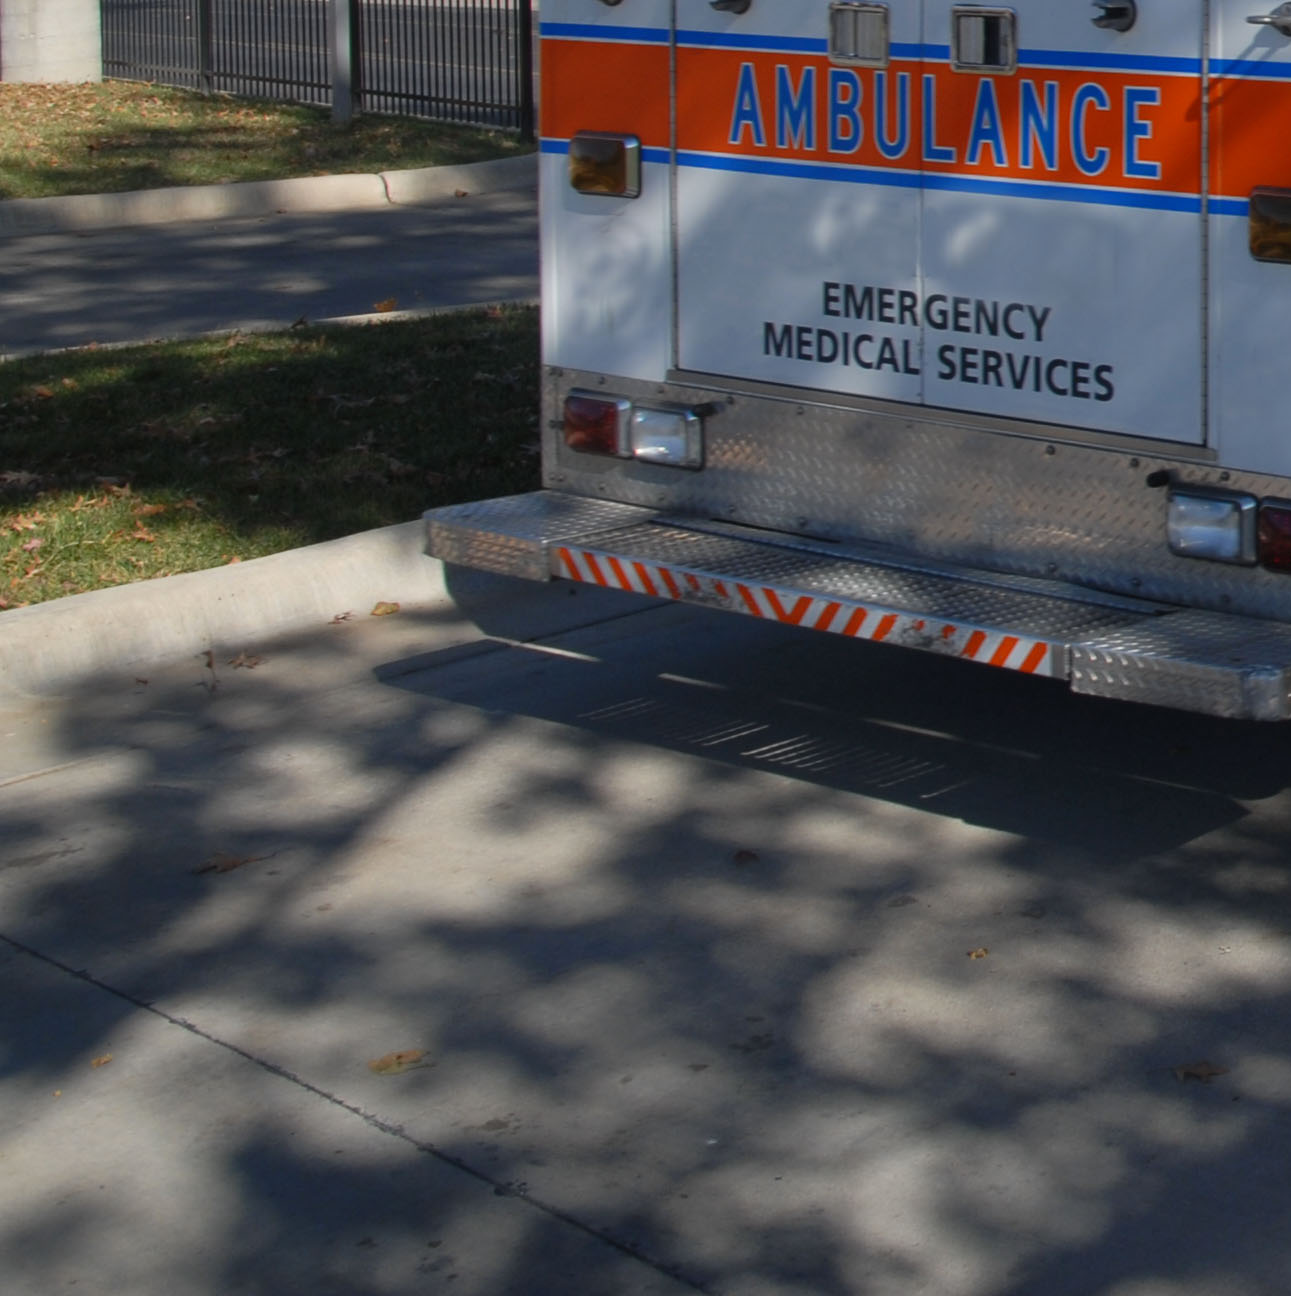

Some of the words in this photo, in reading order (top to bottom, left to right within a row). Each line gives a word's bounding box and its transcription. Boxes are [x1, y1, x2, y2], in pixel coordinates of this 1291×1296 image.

[729, 62, 1163, 181] AMBULANCE
[822, 281, 1051, 342] EMERGENCY
[762, 321, 921, 376] MEDICAL
[937, 343, 1115, 403] SERVICES
